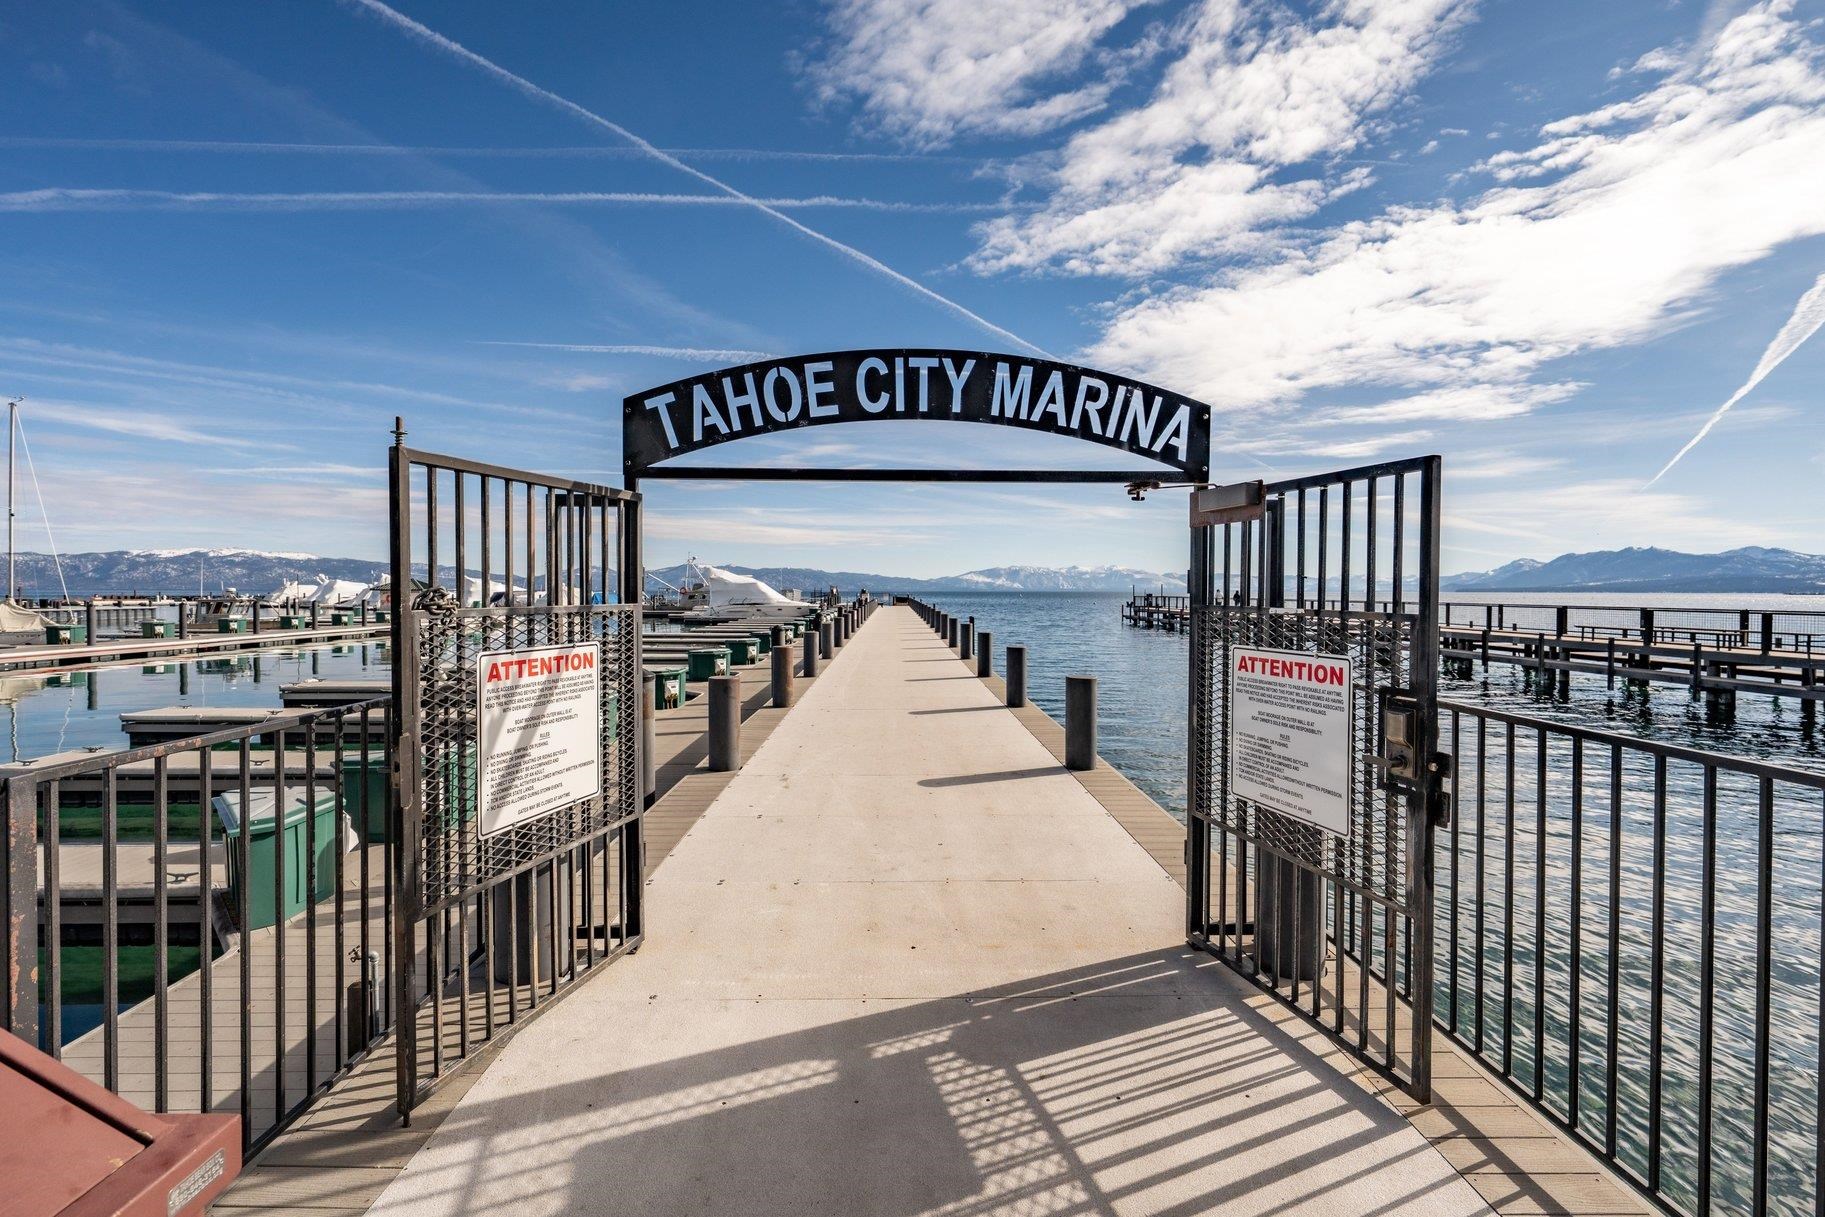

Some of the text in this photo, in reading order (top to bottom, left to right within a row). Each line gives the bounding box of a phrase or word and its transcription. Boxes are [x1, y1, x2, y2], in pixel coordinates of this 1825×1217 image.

[644, 356, 1191, 463] TAHOE CITY MARINA
[487, 652, 594, 682] ATTENTION
[1237, 655, 1344, 686] ATTENTION
